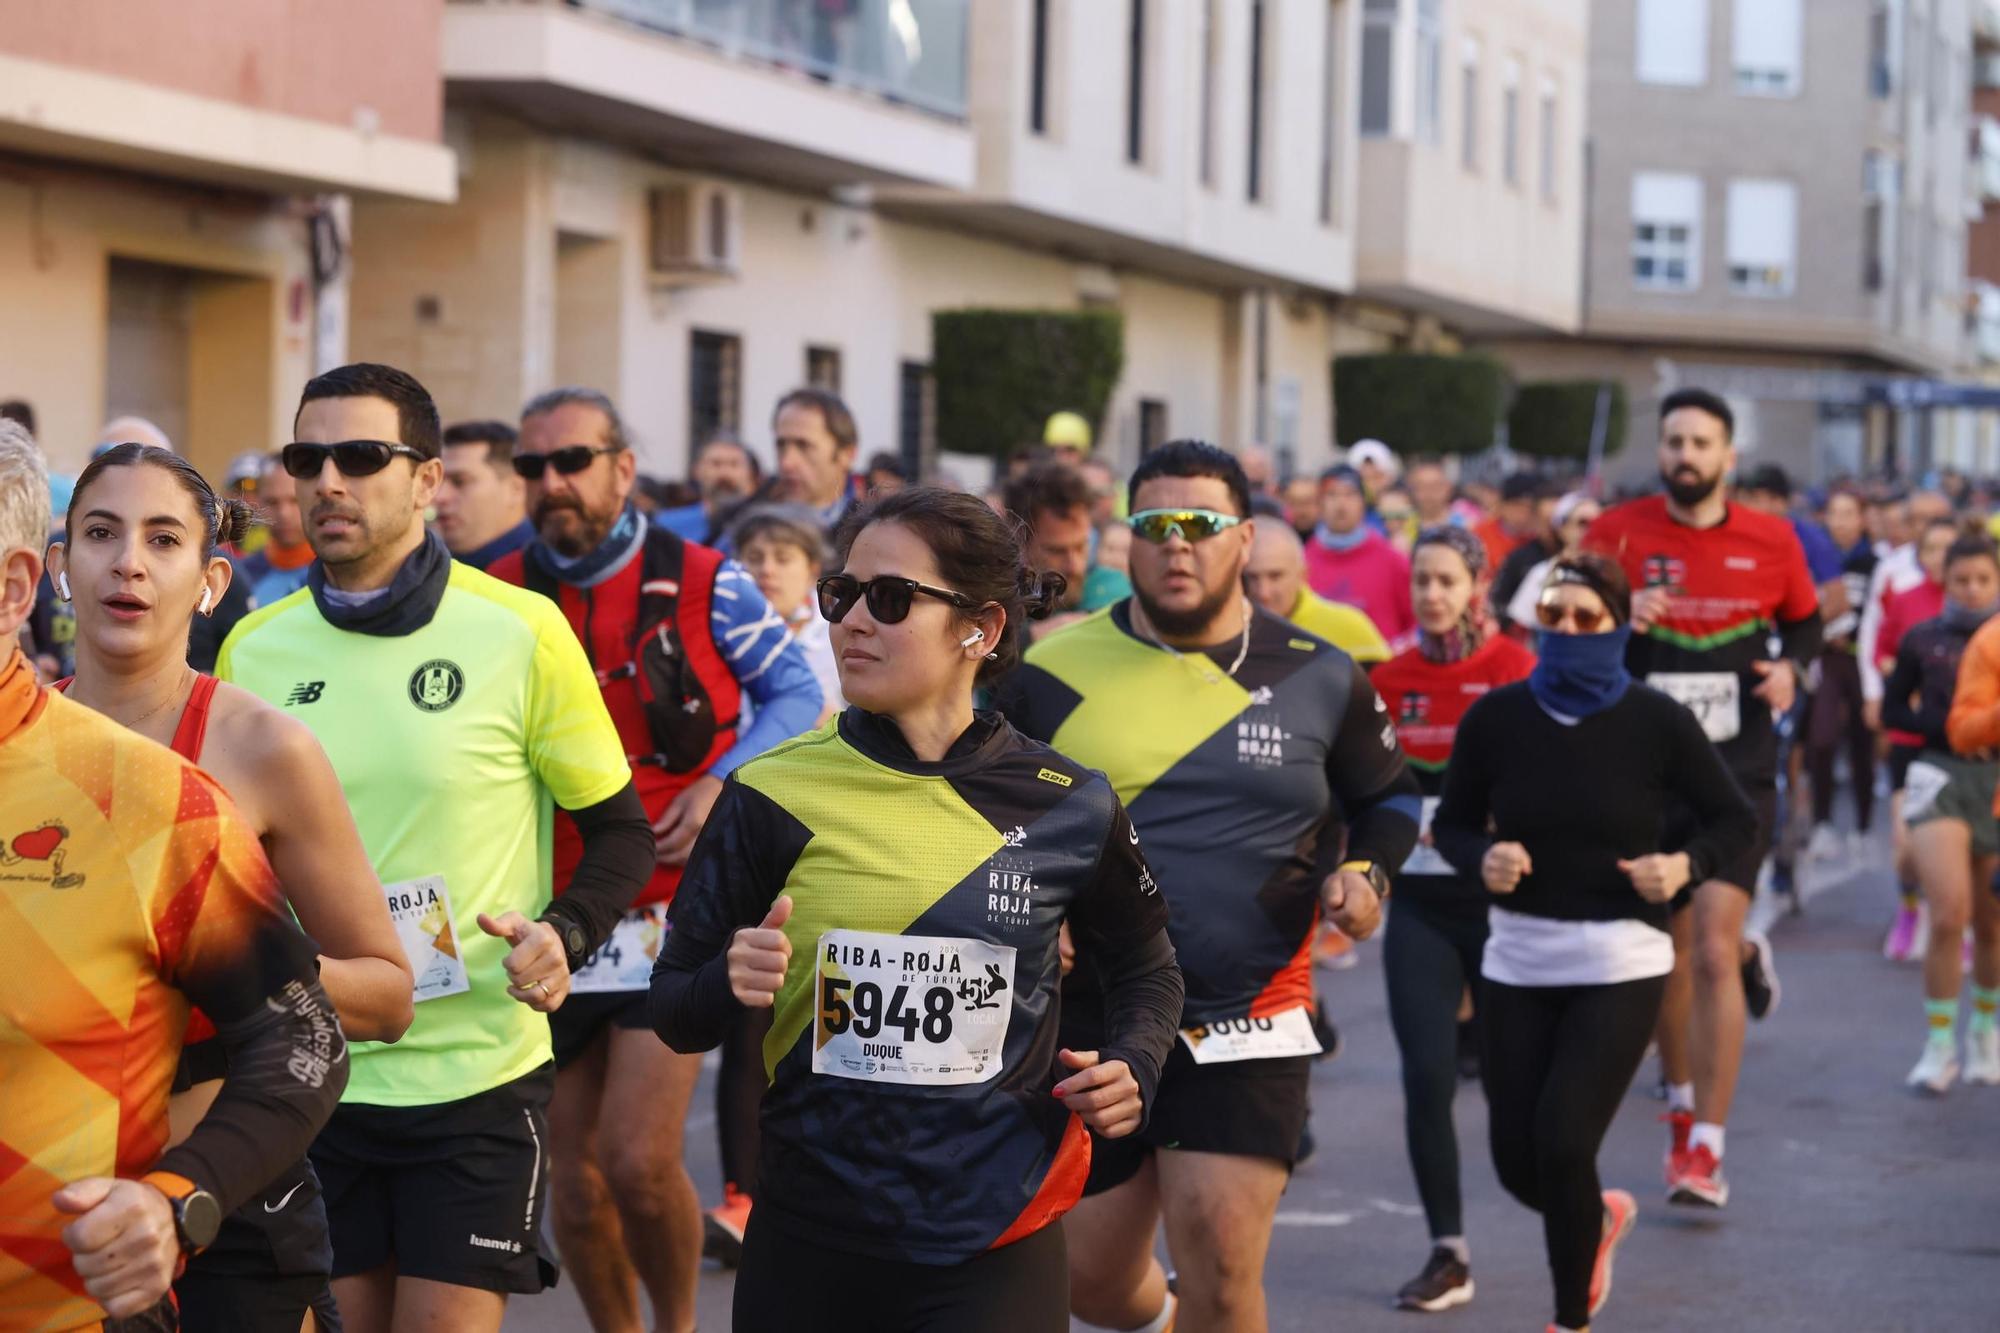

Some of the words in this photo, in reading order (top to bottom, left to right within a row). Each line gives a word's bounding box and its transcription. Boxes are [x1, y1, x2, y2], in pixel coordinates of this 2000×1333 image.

[989, 872, 1039, 893] RIBA-
[902, 973, 916, 983] DE
[823, 977, 955, 1044] 5948
[863, 1043, 903, 1060] DUQUE
[470, 1234, 511, 1251] luanvi
